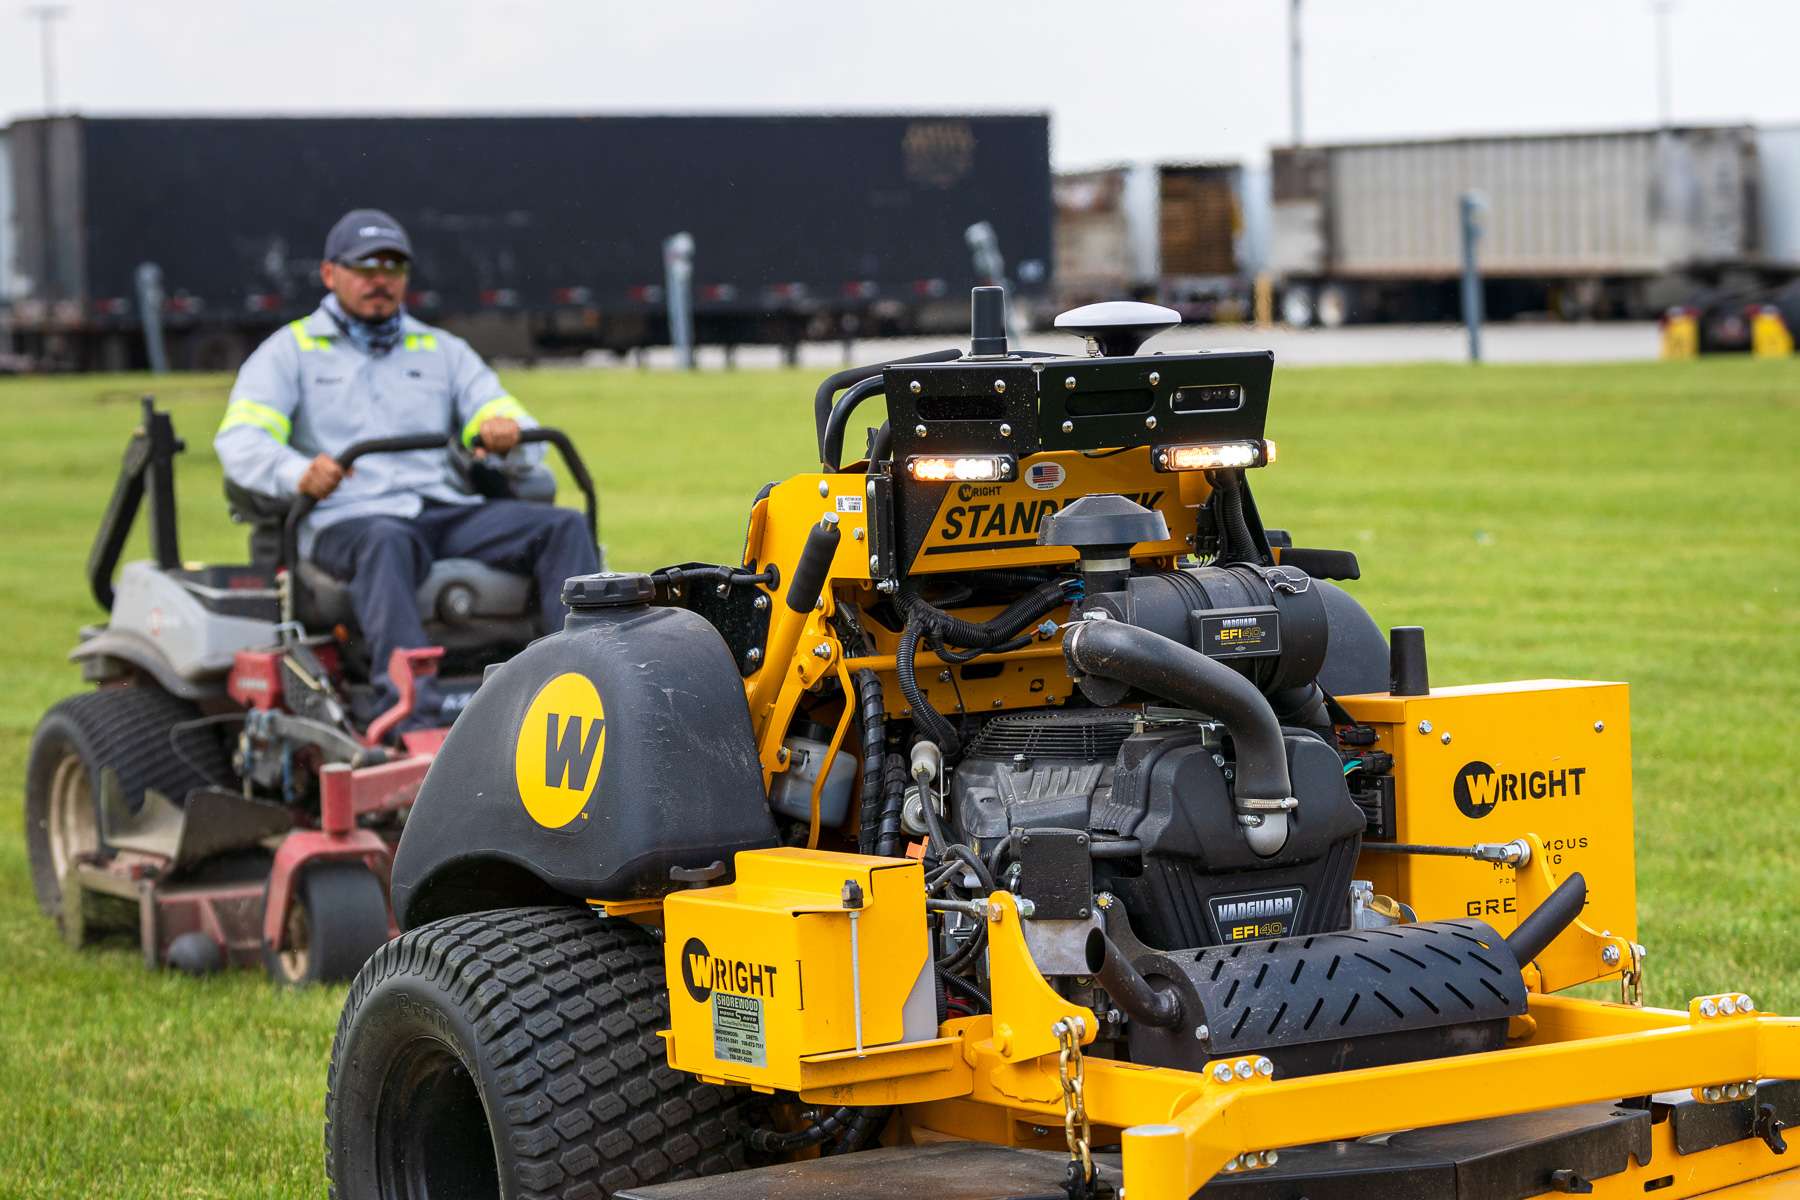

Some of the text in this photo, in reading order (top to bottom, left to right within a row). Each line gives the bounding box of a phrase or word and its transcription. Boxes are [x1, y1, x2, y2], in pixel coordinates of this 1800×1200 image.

[961, 485, 1002, 500] WRIGHT
[1222, 617, 1257, 628] VANGUARD
[545, 713, 604, 792] W
[1460, 764, 1586, 812] WRIGHT
[1217, 896, 1293, 922] VANGUARD
[685, 944, 777, 999] WRIGHT
[716, 993, 759, 1012] SHOREWOOD
